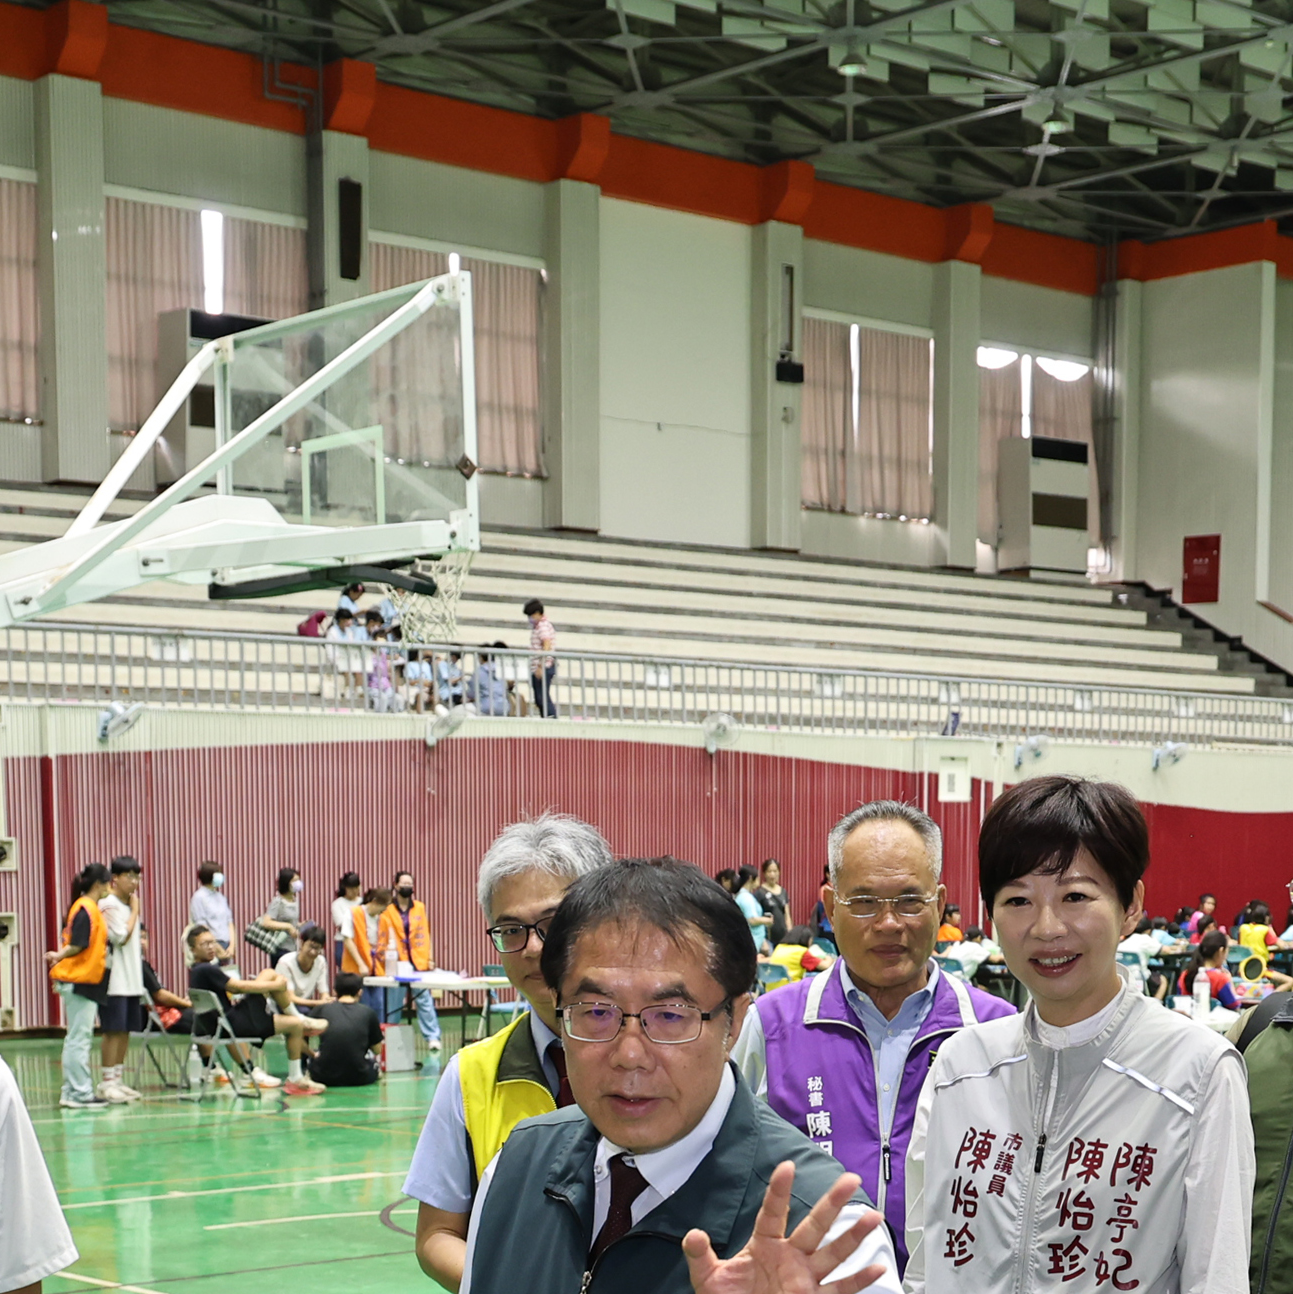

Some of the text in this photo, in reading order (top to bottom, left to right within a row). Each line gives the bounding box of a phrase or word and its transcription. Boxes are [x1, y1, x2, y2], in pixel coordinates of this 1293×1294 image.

[944, 1127, 996, 1267] 陳怡珍
[986, 1133, 1023, 1197] 市議員
[1048, 1137, 1108, 1282] 陳怡珍
[1094, 1143, 1157, 1291] 陳亭妃
